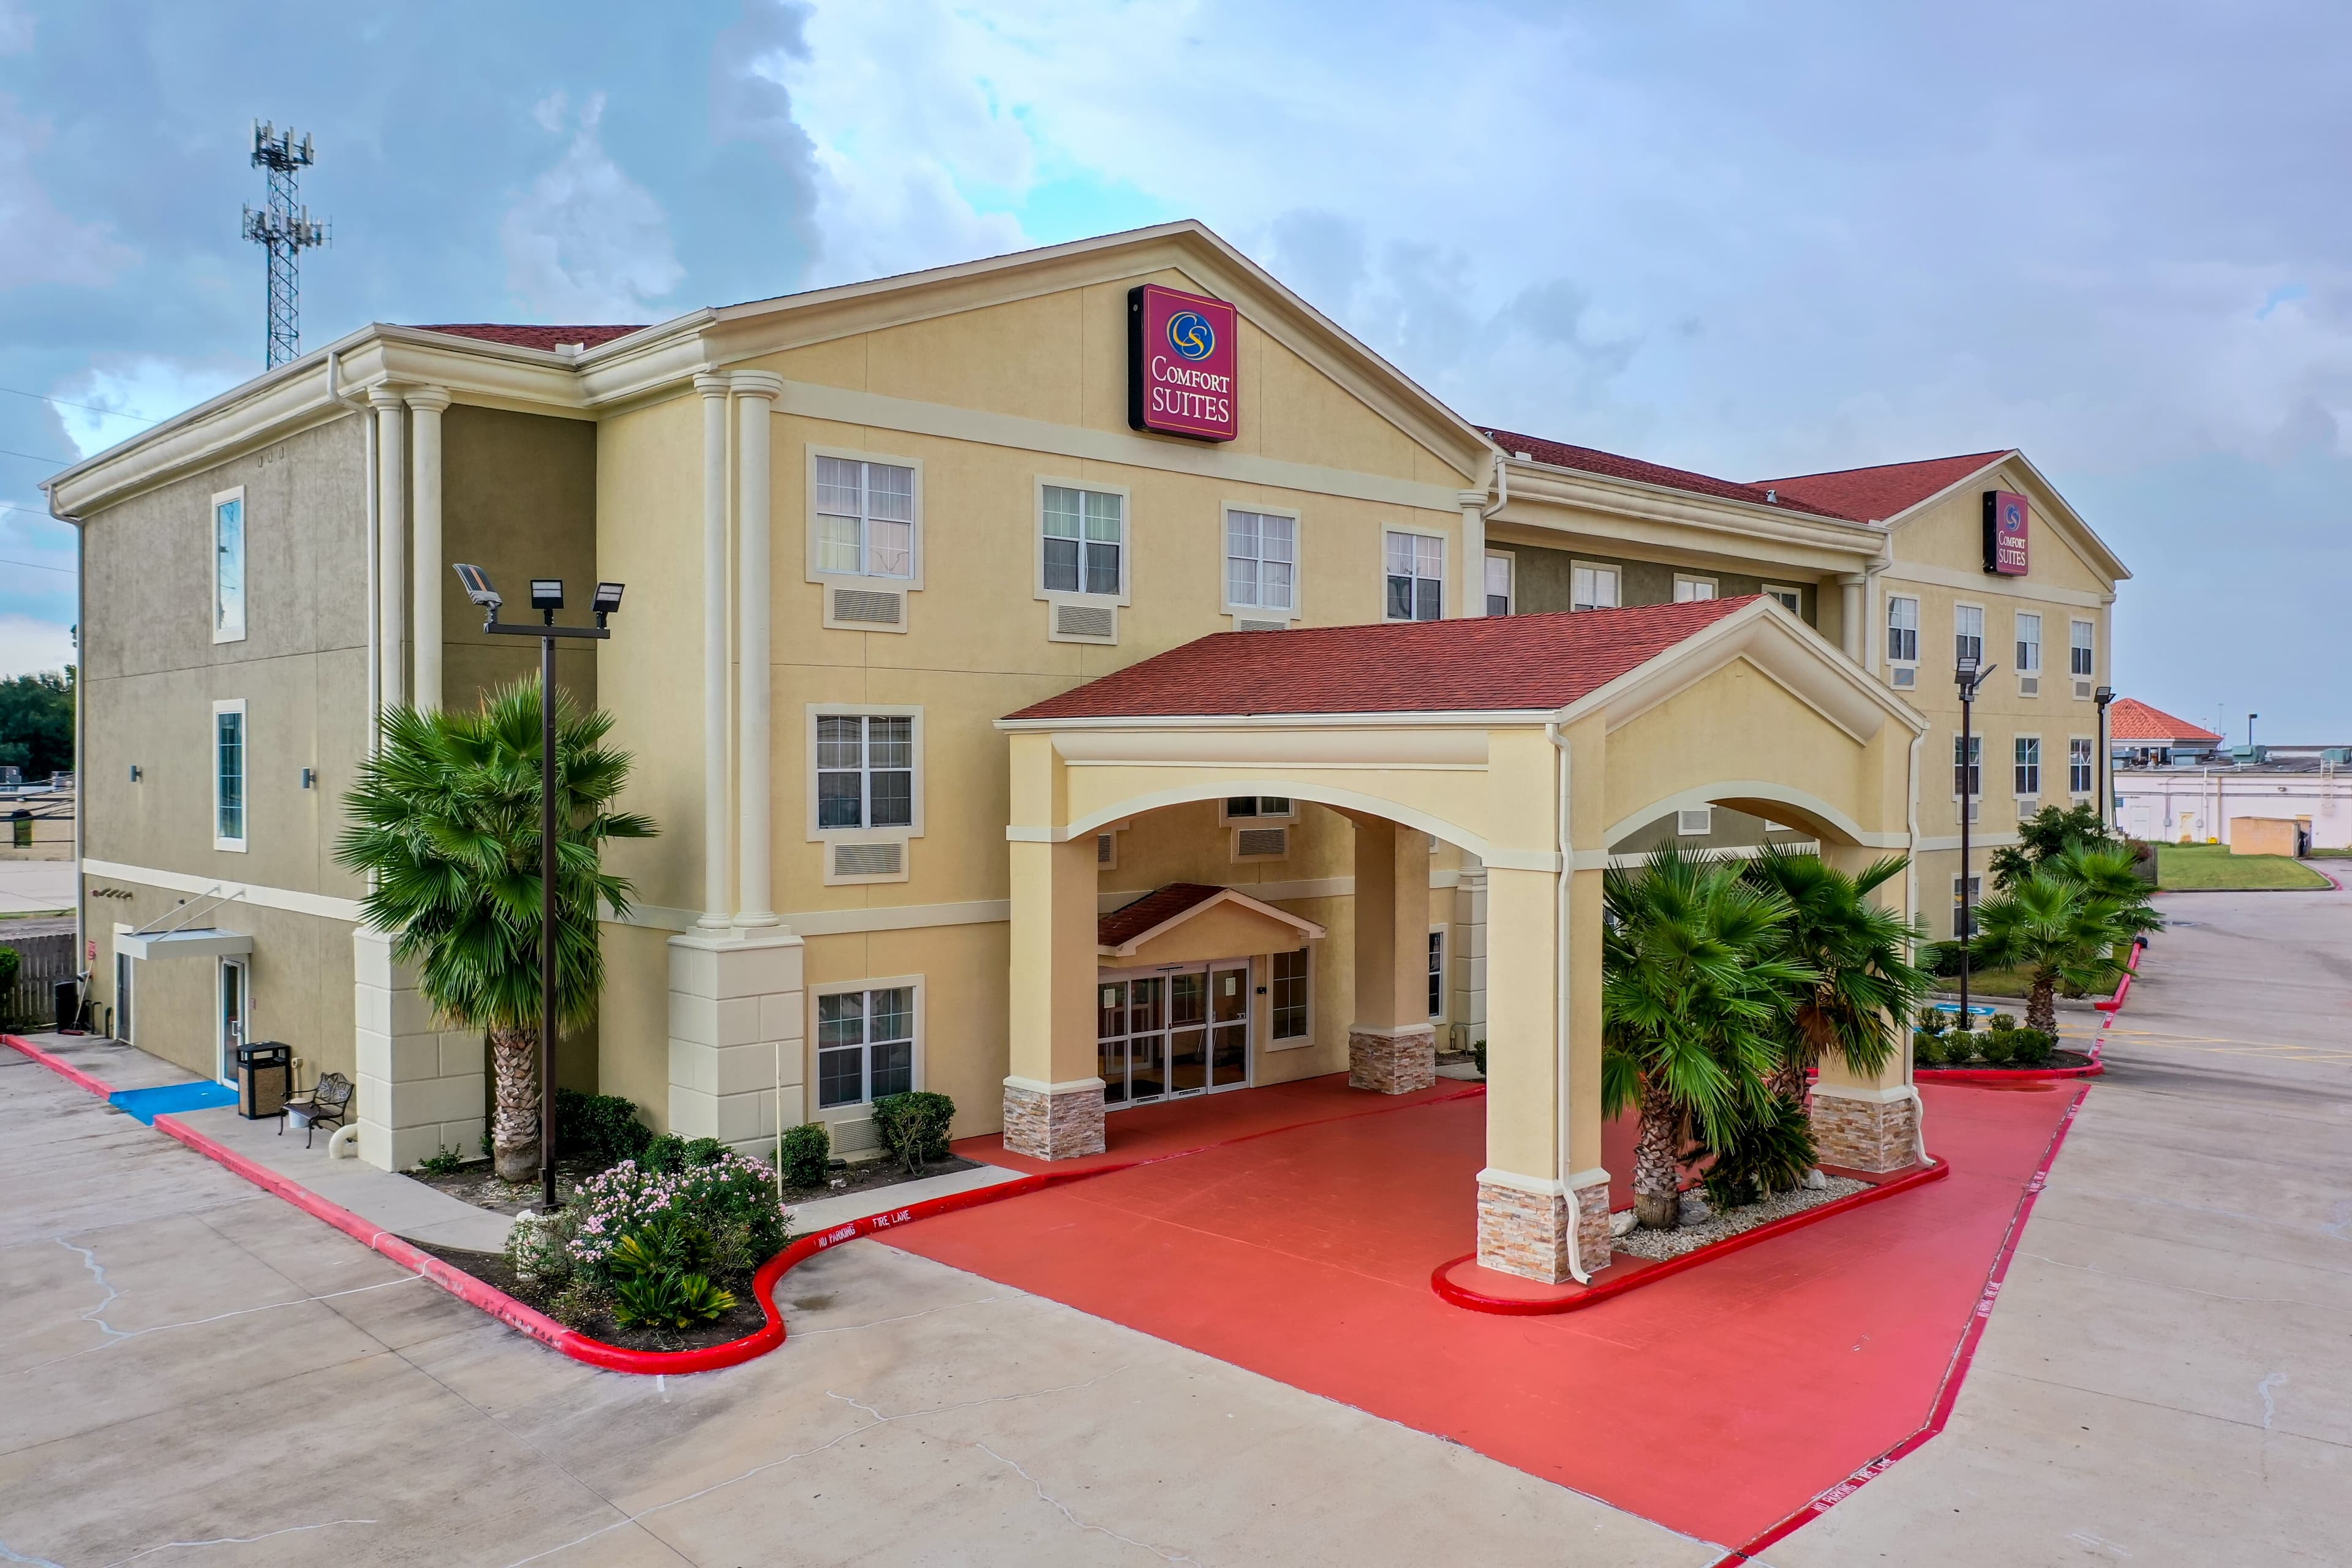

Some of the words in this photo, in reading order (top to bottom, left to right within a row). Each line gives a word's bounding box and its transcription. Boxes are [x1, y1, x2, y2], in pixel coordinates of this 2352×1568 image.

[1152, 355, 1229, 393] COMFORT
[1152, 386, 1229, 423] SUITES
[1999, 530, 2026, 549] COMFORT
[1999, 548, 2026, 566] SUITES
[828, 1225, 856, 1244] PARKING
[872, 1215, 889, 1228] FIRE
[891, 1210, 911, 1223] LANE
[1811, 1502, 1830, 1512] NO
[1822, 1483, 1857, 1504] PARKING
[1854, 1468, 1878, 1482] FIRE
